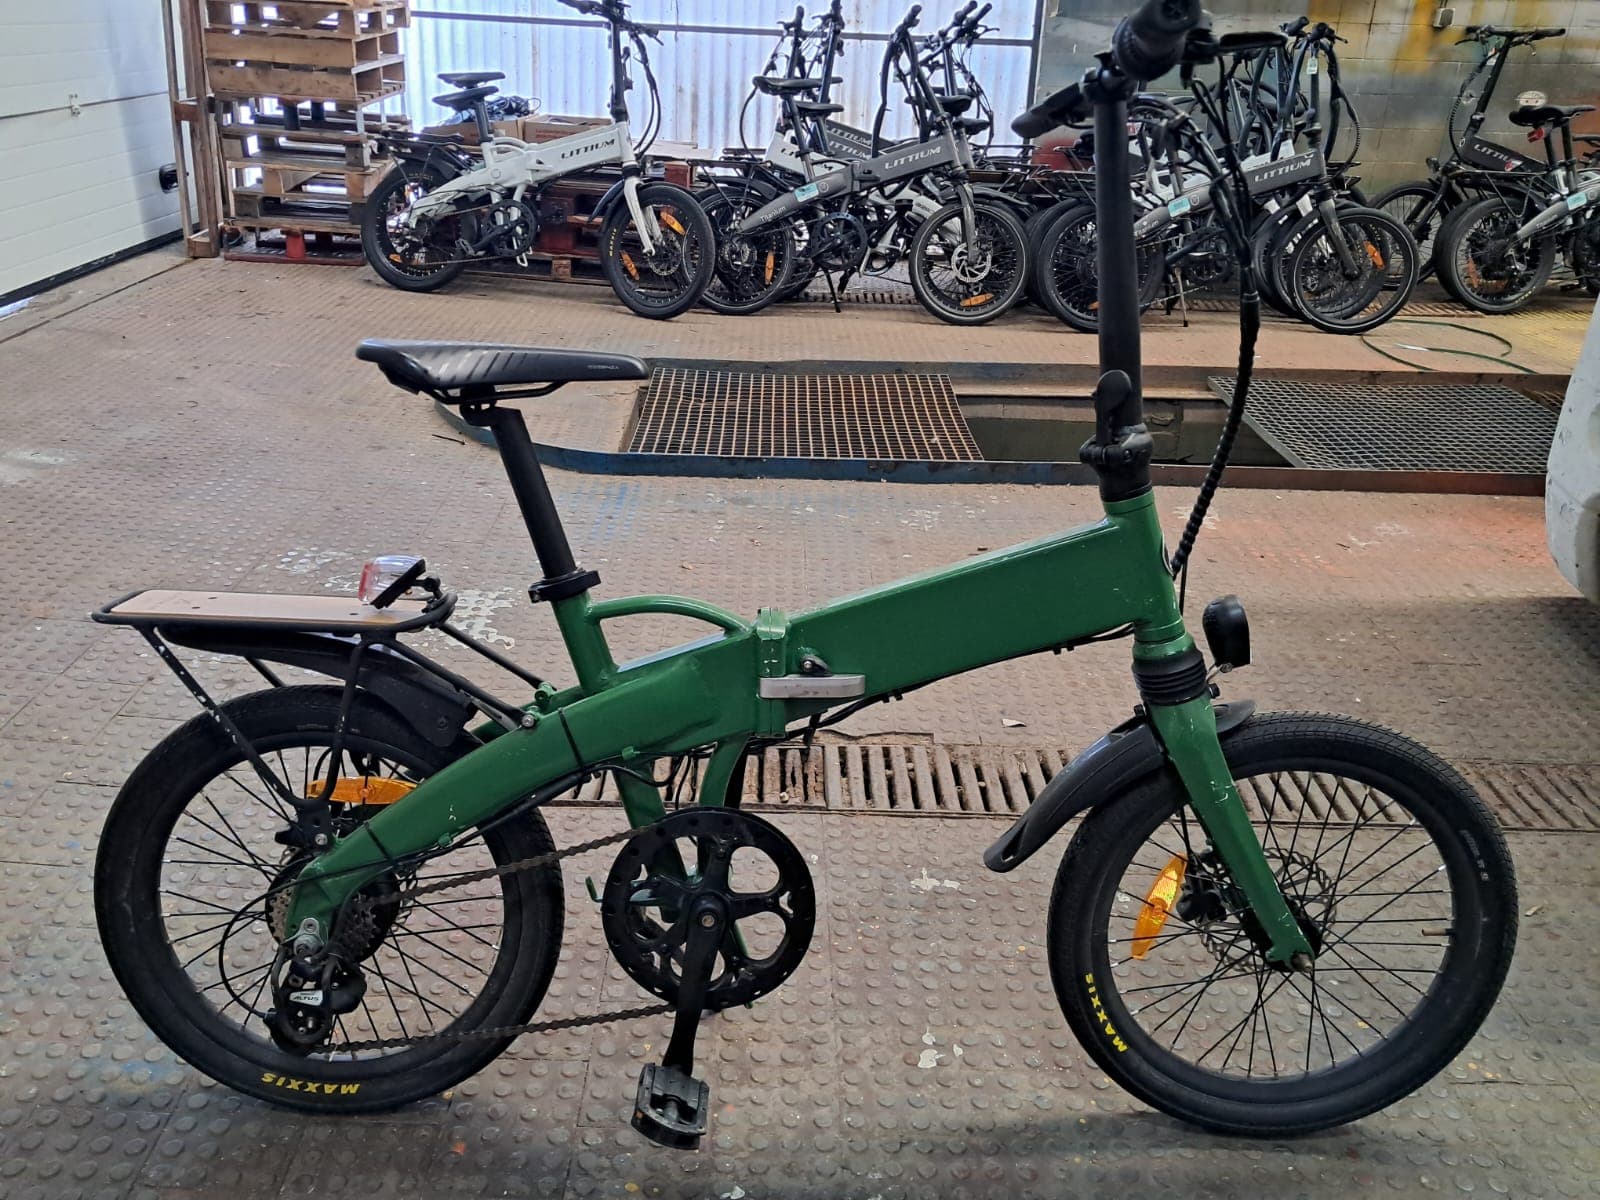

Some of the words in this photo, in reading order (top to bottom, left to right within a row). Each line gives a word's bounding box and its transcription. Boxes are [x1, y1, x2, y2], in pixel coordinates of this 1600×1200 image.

[828, 126, 872, 146] ITTIUM
[561, 138, 615, 159] LITTIUM
[829, 140, 872, 160] ITTIUM
[884, 145, 941, 169] LITTIUM
[1254, 158, 1312, 182] LITTIUM
[1085, 972, 1129, 1053] MAXXIS
[261, 1072, 361, 1095] MAXXIS
